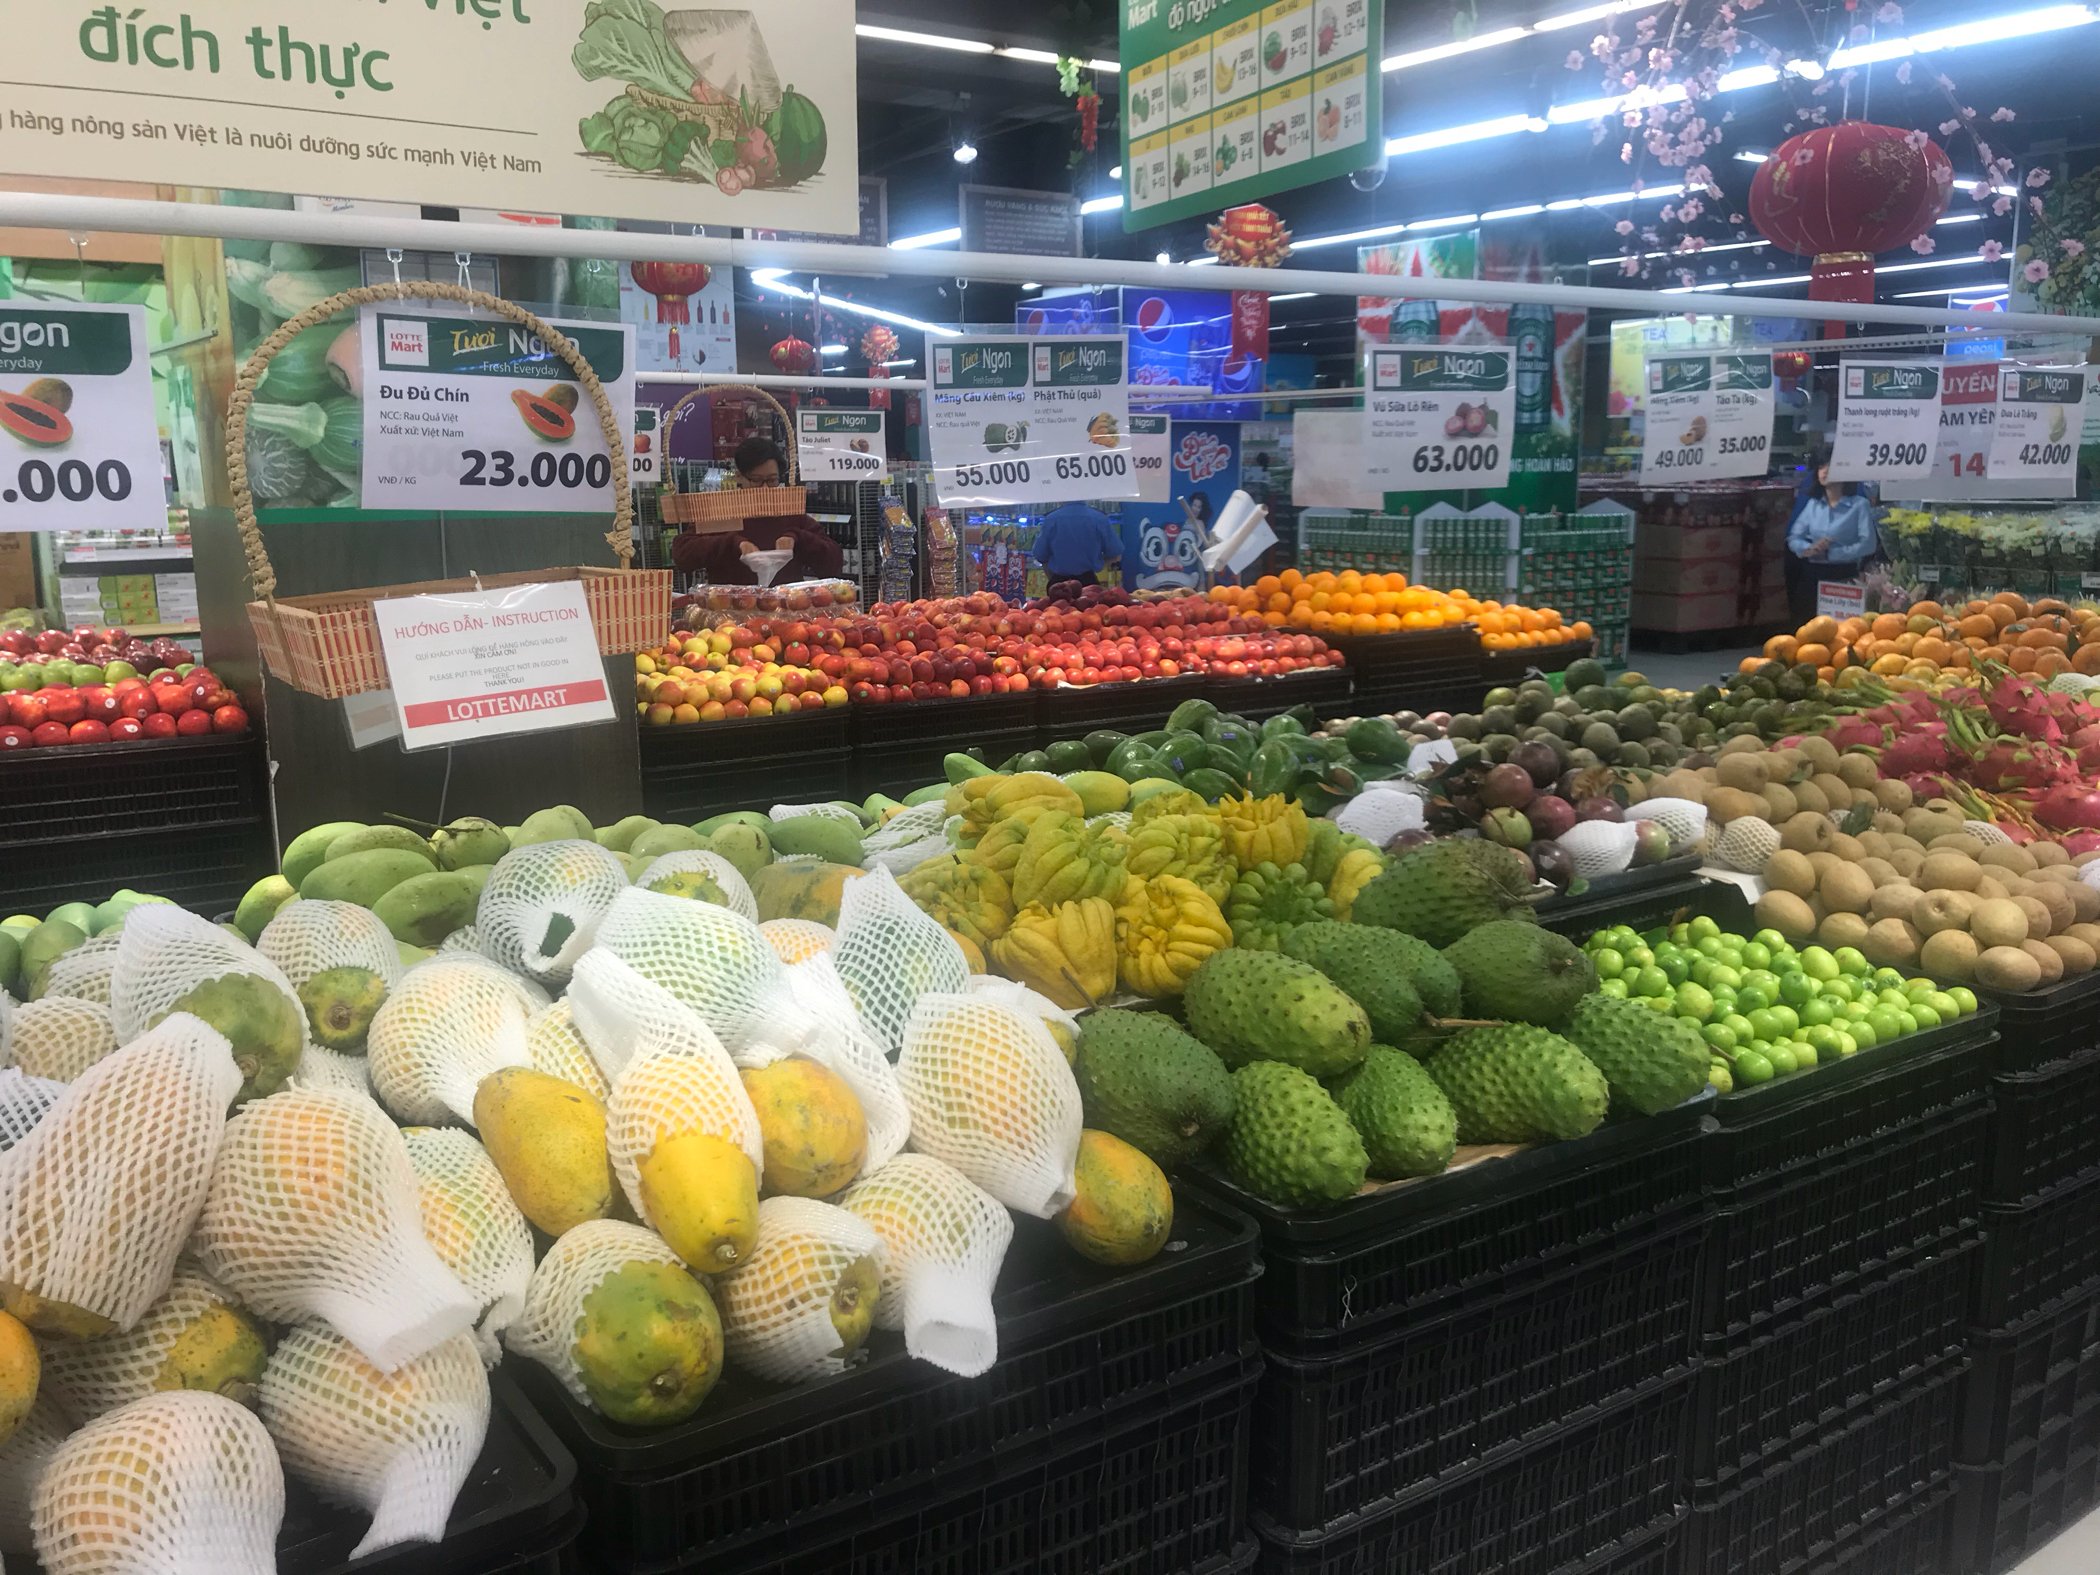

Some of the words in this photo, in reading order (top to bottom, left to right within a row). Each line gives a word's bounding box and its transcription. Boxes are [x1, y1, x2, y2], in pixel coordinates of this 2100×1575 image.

[1127, 2, 1158, 31] Mart
[1168, 2, 1185, 32] độ
[79, 5, 220, 74] đích
[245, 25, 394, 100] thực
[10, 109, 64, 136] hàng
[72, 115, 125, 140] nông
[132, 119, 168, 141] sản
[174, 123, 219, 147] Việt
[225, 126, 243, 146] là
[250, 131, 293, 151] nuôi
[300, 135, 361, 161] dưỡng
[366, 141, 398, 161] sức
[403, 148, 455, 168] mạnh
[460, 150, 498, 173] Việt
[503, 154, 542, 174] Nam
[390, 332, 423, 342] LOTTE
[1641, 328, 1667, 341] TEA
[390, 341, 424, 353] Mart
[982, 348, 1012, 373] Ngon
[1079, 346, 1106, 372] Ngon
[1444, 355, 1485, 379] Ngon
[483, 361, 511, 374] Fresh
[513, 363, 560, 377] Everyday
[1746, 362, 1767, 377] Ngon
[1893, 369, 1922, 388] Ngon
[379, 385, 403, 400] Đu
[407, 385, 431, 402] Đủ
[434, 386, 470, 403] Chín
[2044, 376, 2070, 395] Ngon
[983, 391, 1007, 402] Xiêm
[1008, 391, 1026, 404] (kg)
[1034, 390, 1056, 403] Phật
[1058, 388, 1075, 400] Thủ
[1077, 389, 1102, 403] (quả)
[1731, 395, 1742, 404] Ta
[379, 411, 402, 421] NCC:
[403, 412, 422, 421] Rau
[422, 411, 441, 423] Quả
[441, 412, 459, 423] Việt
[842, 415, 867, 427] Ngon
[1844, 407, 1863, 416] Thanh
[379, 425, 402, 435] Xuất
[421, 427, 441, 437] Việt
[442, 428, 464, 438] Nam
[1135, 417, 1155, 429] Ngon
[1718, 435, 1766, 454] 35.000
[829, 458, 880, 470] 119.000
[1412, 444, 1499, 473] 63.000
[1655, 447, 1704, 469] 49.000
[1865, 443, 1928, 467] 39.900
[2019, 444, 2071, 465] 42.000
[459, 449, 612, 489] 23.000
[956, 460, 1031, 487] 55.000
[1056, 454, 1127, 479] 65.000
[1948, 452, 1986, 477] 14
[378, 476, 398, 485] VNĐ
[404, 476, 417, 485] KG
[394, 620, 450, 640] HƯỚNG
[492, 607, 579, 628] INSTRUCTION
[453, 648, 467, 656] VUI
[474, 651, 486, 660] XIN
[429, 673, 454, 682] PLEASE
[455, 671, 469, 679] PUT
[470, 669, 483, 677] THE
[484, 664, 516, 675] PRODUCT
[517, 663, 531, 671] NOT
[540, 659, 560, 668] GOOD
[484, 678, 507, 688] THANK
[446, 688, 567, 721] LOTTEMART
